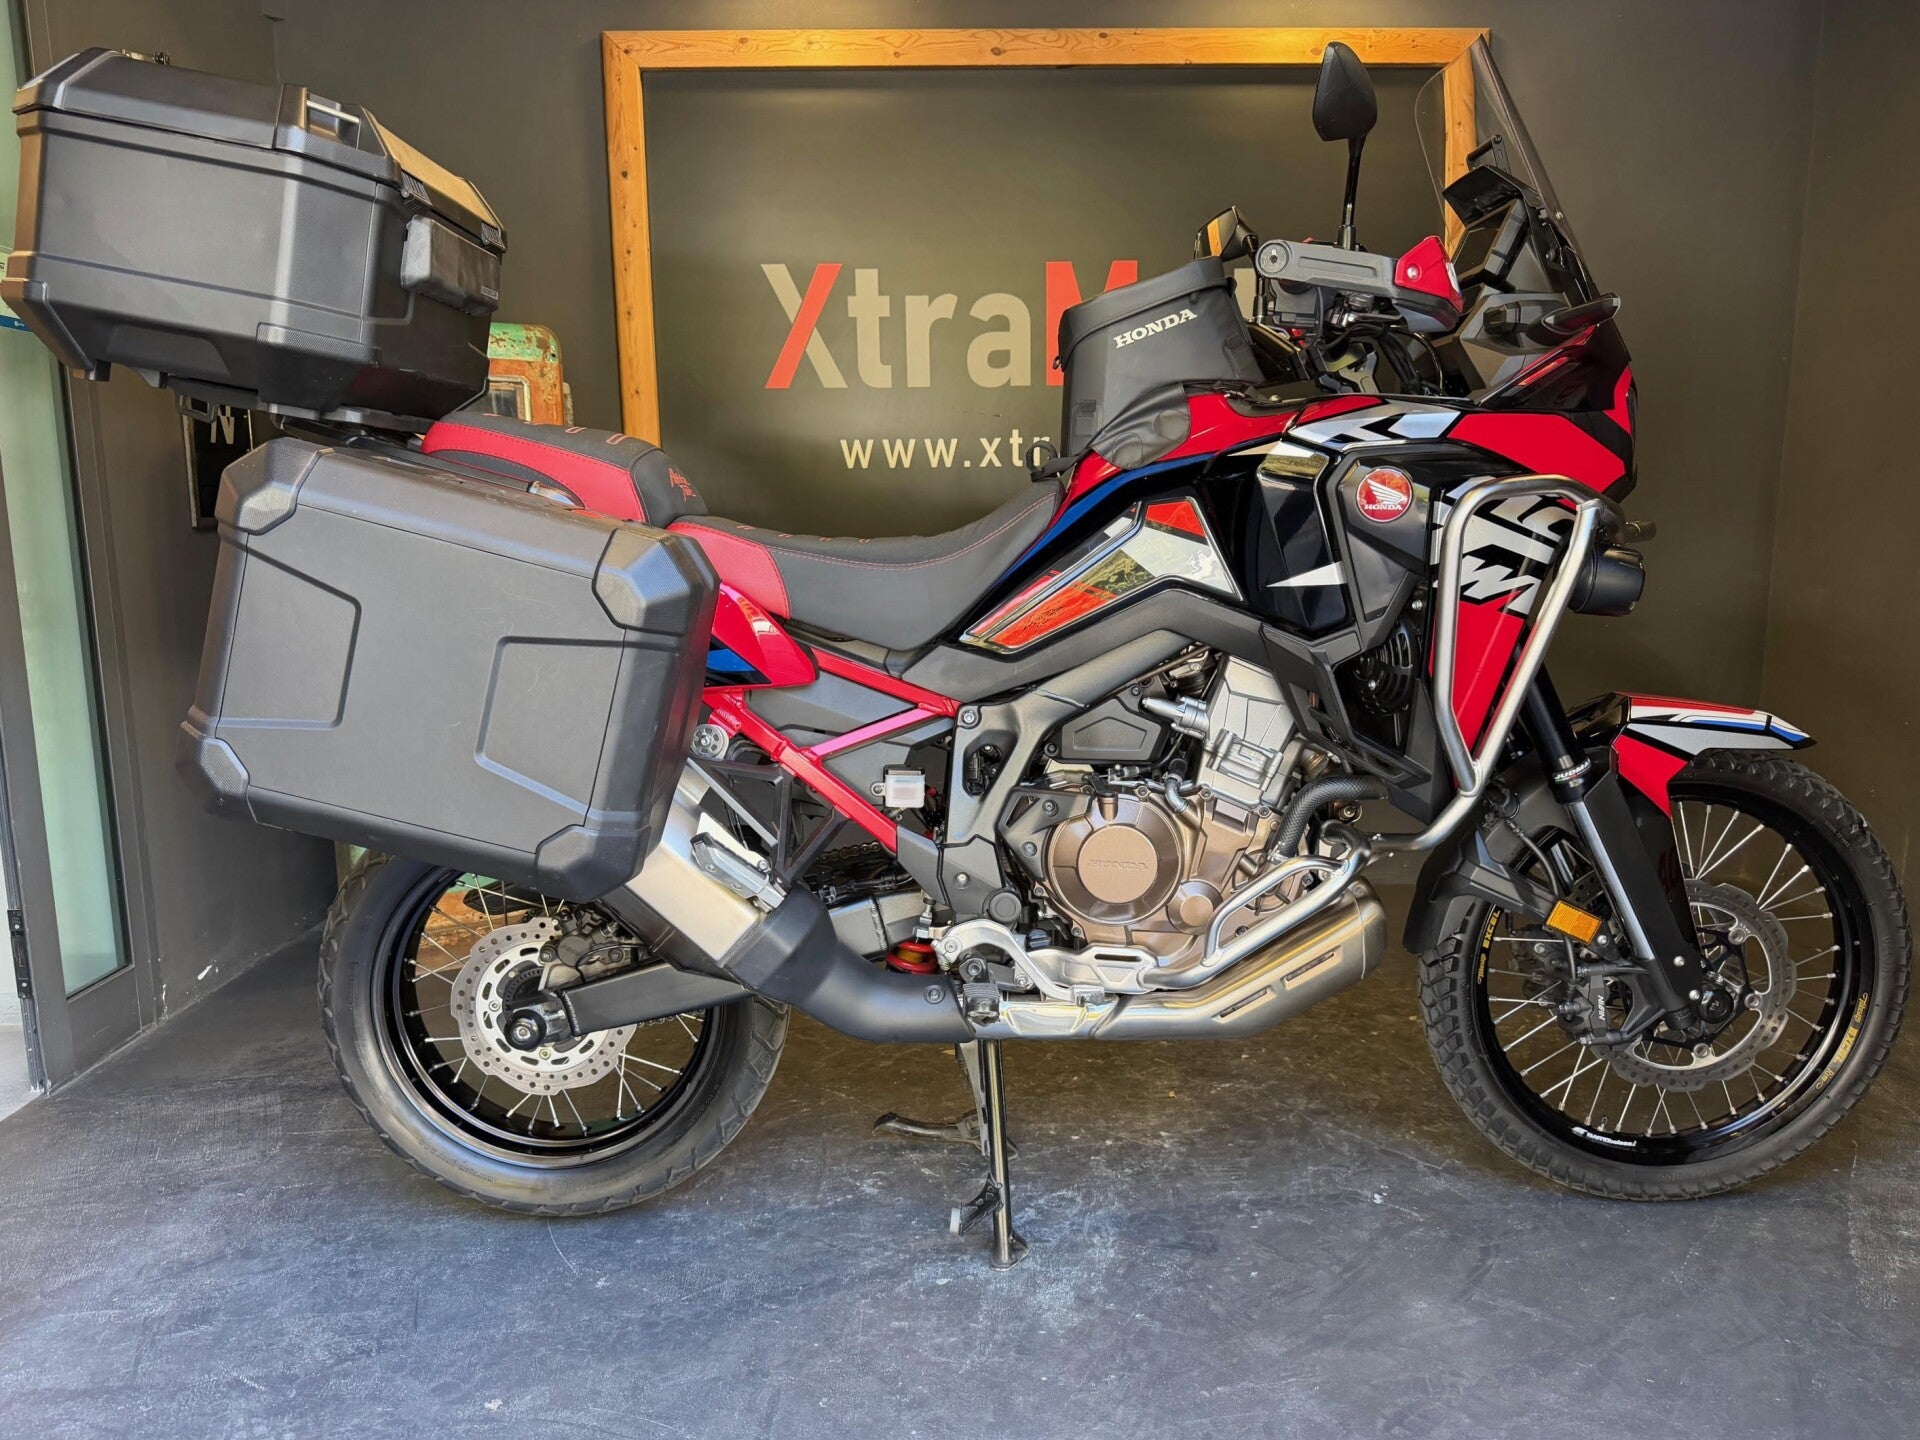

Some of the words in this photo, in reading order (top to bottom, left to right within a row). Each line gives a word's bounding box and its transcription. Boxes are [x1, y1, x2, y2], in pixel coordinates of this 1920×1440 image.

[1113, 308, 1198, 349] HONDA
[1088, 859, 1149, 871] HONDA
[1482, 910, 1502, 949] EXCEL
[1833, 1026, 1860, 1064] EXCEL
